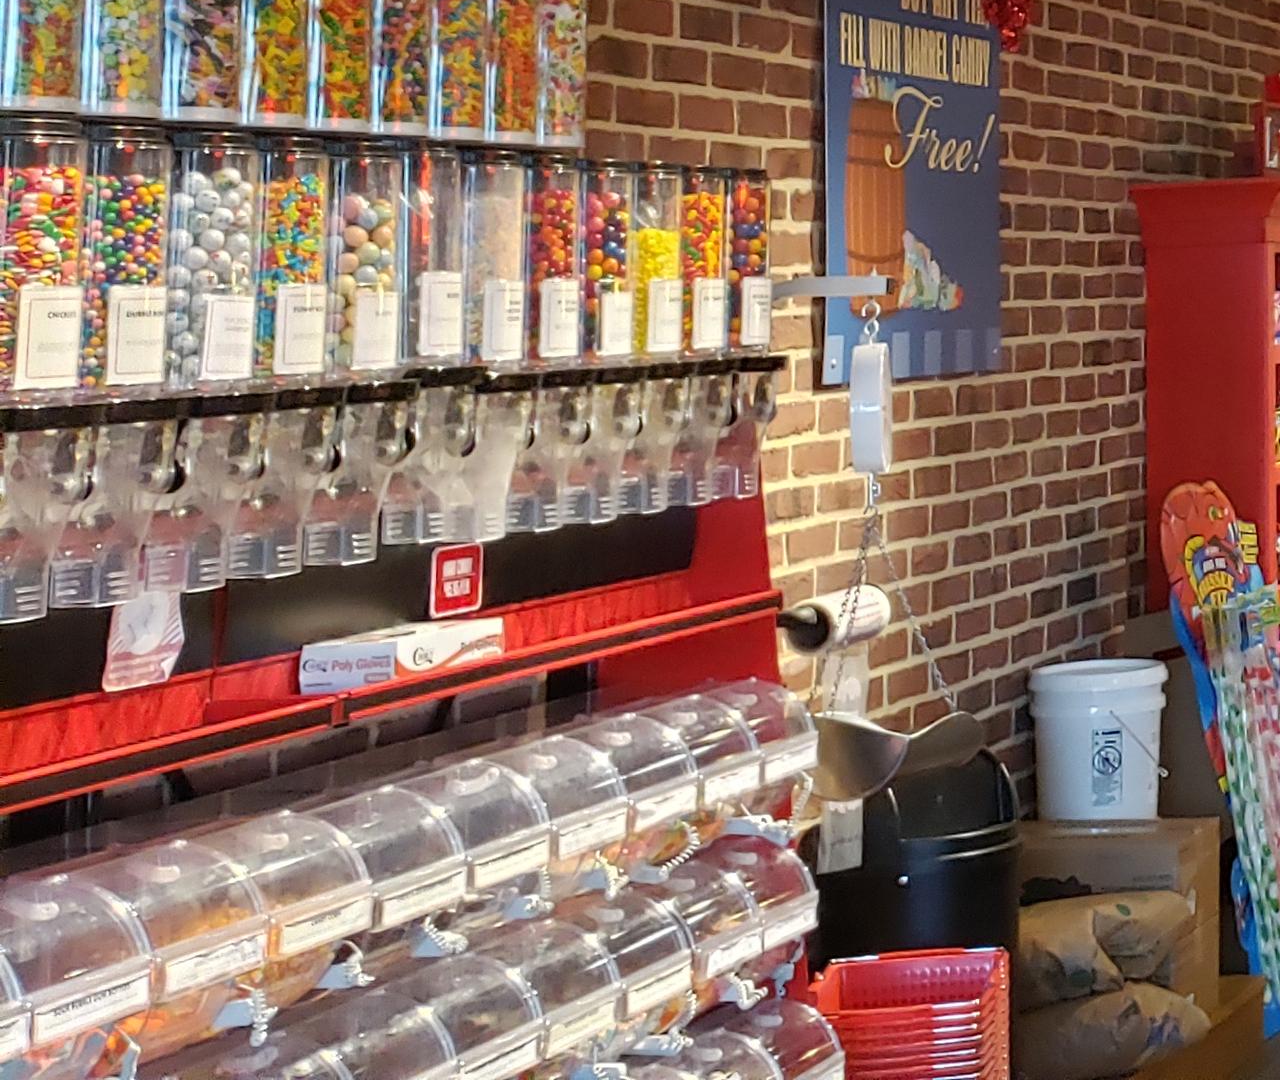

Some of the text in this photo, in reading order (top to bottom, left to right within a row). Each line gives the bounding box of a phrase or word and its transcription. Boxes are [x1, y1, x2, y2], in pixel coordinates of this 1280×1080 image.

[839, 11, 991, 88] FILL WITH BARREL CANDY
[884, 85, 996, 174] Free!
[331, 660, 353, 672] Poly
[356, 658, 391, 670] Gloves
